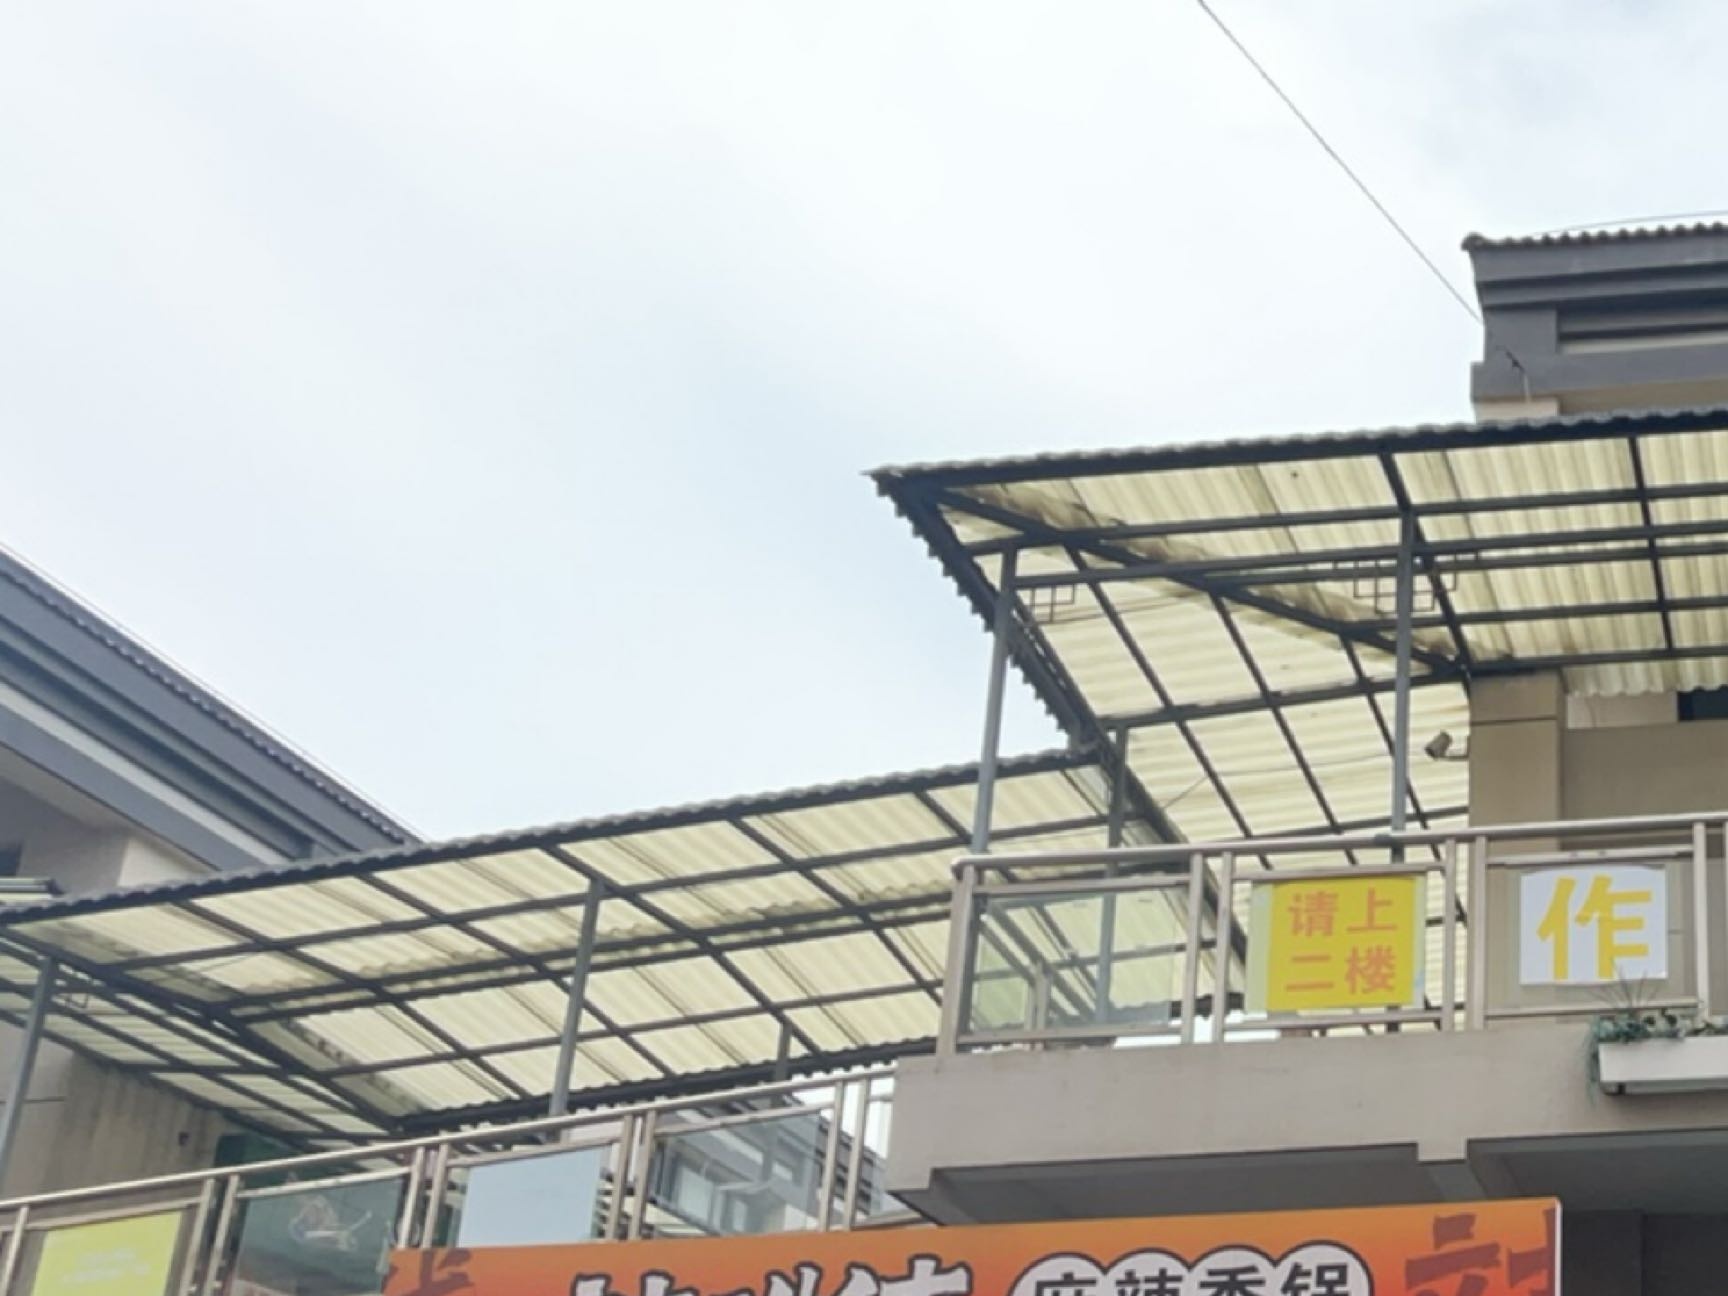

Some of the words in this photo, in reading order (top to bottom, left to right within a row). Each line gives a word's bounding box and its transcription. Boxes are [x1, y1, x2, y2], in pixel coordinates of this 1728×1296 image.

[1286, 888, 1398, 937] 请上
[1536, 874, 1653, 981] 作
[1284, 945, 1398, 996] 二楼
